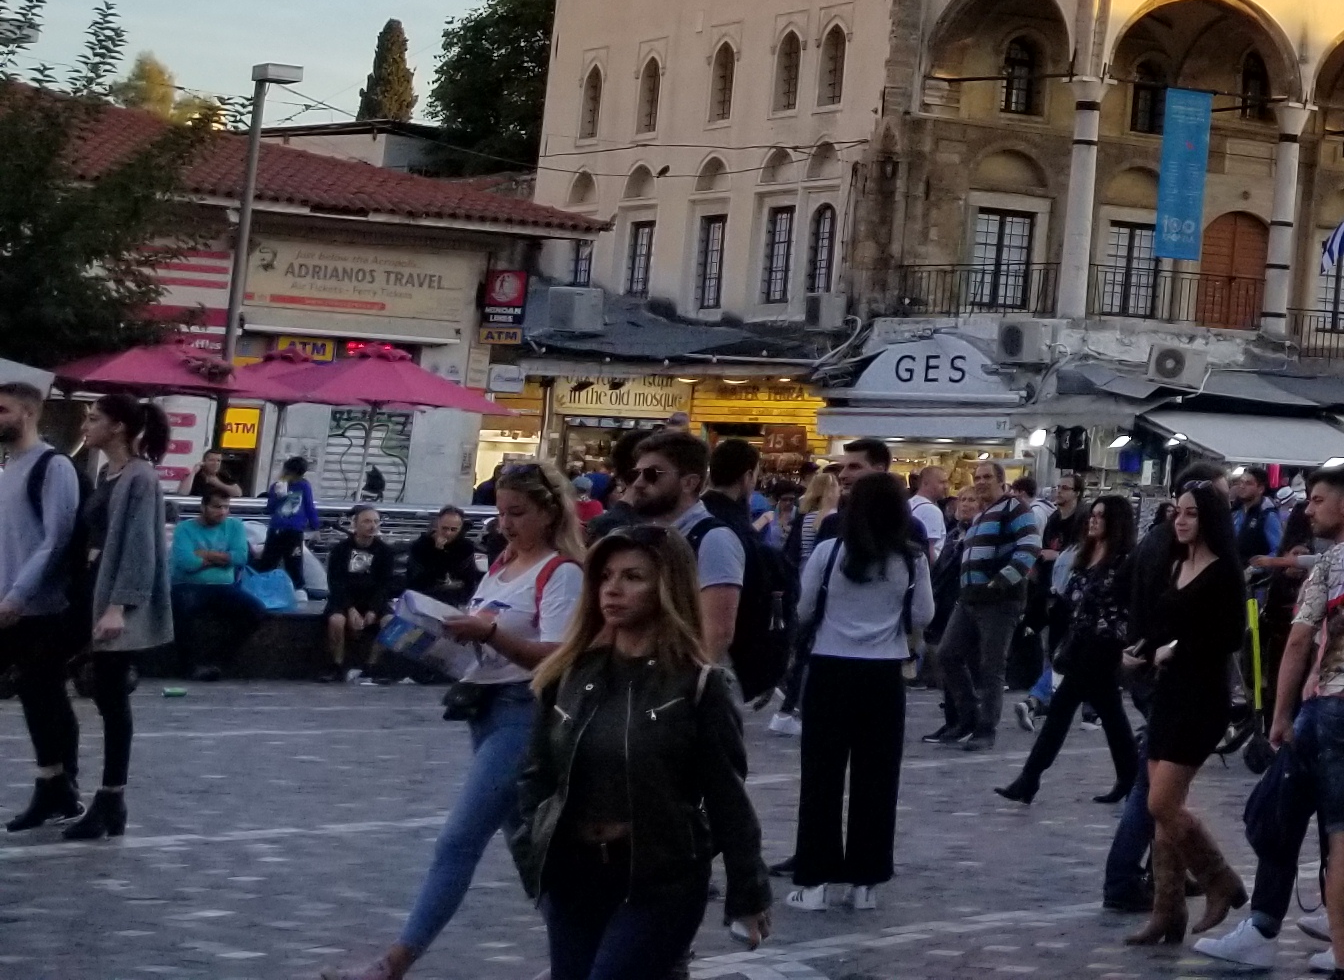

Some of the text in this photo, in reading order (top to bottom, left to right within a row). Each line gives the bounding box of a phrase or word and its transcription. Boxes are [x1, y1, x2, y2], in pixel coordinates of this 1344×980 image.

[352, 254, 368, 263] the
[285, 262, 444, 290] ADRIANOS TRAVEL
[485, 331, 517, 341] ATM
[287, 340, 327, 356] ATM
[895, 354, 967, 383] GES
[585, 388, 607, 404] the
[609, 389, 631, 406] old
[634, 392, 683, 410] mosque
[223, 422, 256, 435] ATM
[767, 433, 802, 448] 15 €
